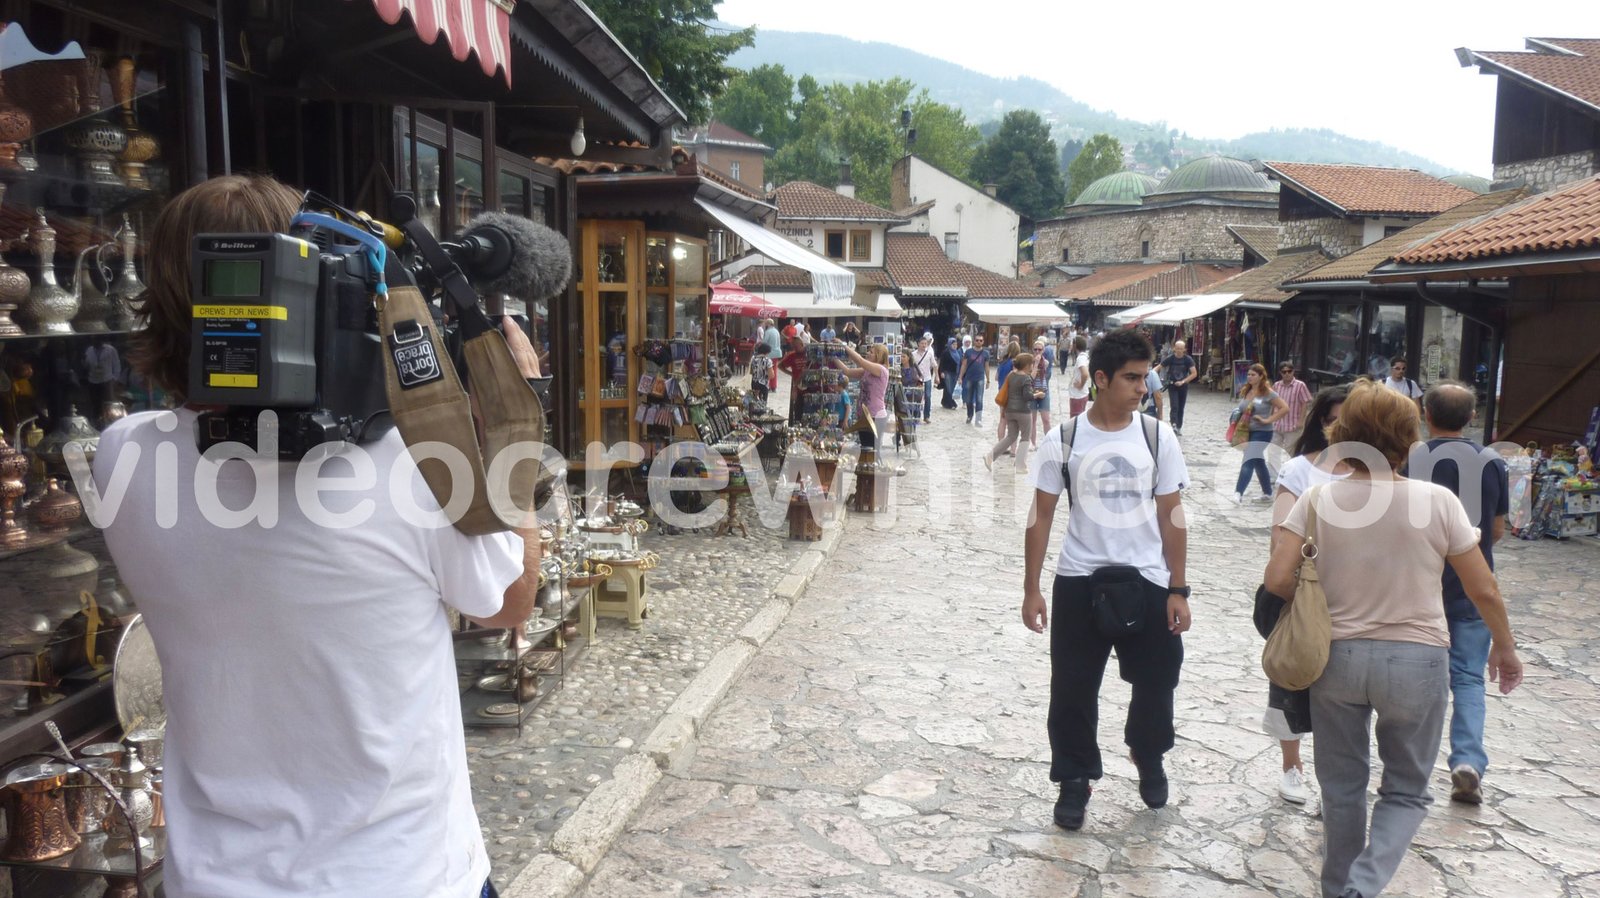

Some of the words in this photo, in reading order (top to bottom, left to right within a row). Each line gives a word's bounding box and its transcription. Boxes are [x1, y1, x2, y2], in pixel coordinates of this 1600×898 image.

[807, 239, 814, 248] 2
[199, 307, 226, 316] CREWS
[229, 308, 244, 316] FOR
[247, 308, 270, 316] NEWS
[398, 344, 431, 362] brace
[401, 356, 434, 377] porta
